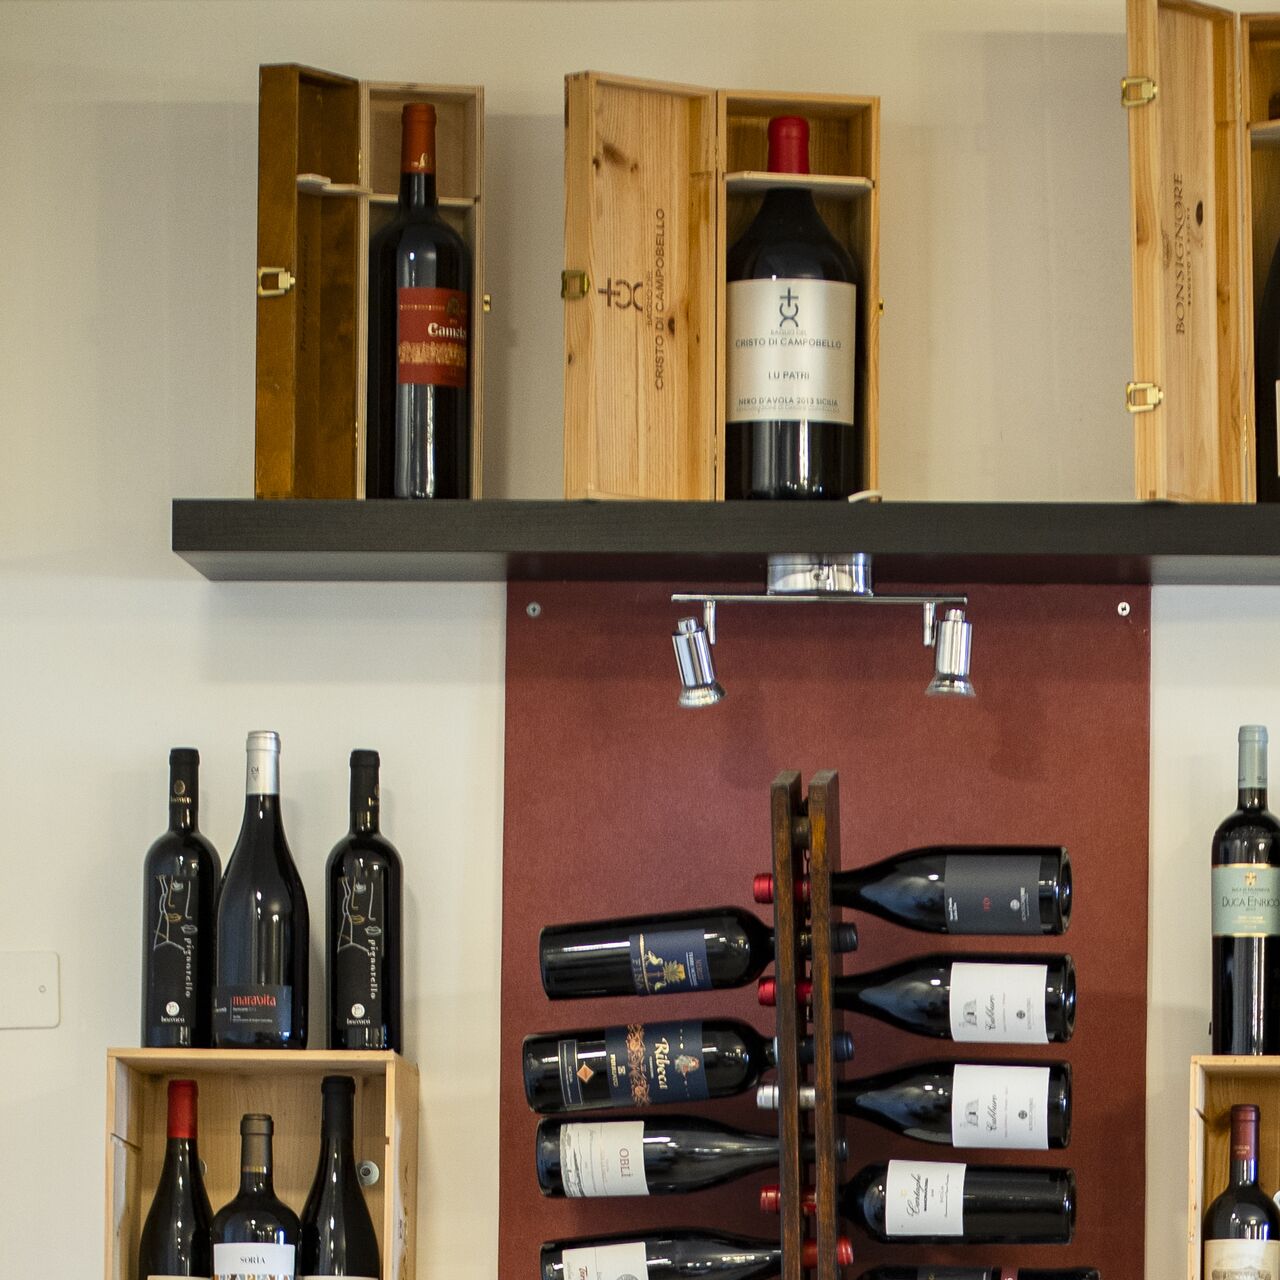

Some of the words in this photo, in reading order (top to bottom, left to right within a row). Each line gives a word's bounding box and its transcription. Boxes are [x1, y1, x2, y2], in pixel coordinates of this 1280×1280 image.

[656, 208, 665, 312] CAMPOBELLO
[1173, 172, 1186, 335] BONSIGNORE
[656, 320, 665, 332] DI
[735, 337, 766, 348] CRISTO
[768, 338, 779, 347] DI
[780, 337, 842, 349] CAMPOBELLO
[656, 337, 665, 391] CRISTO
[738, 398, 757, 406] NERO
[1221, 896, 1246, 907] DUCA
[1246, 896, 1280, 908] ENRICO
[232, 992, 276, 1007] maravita
